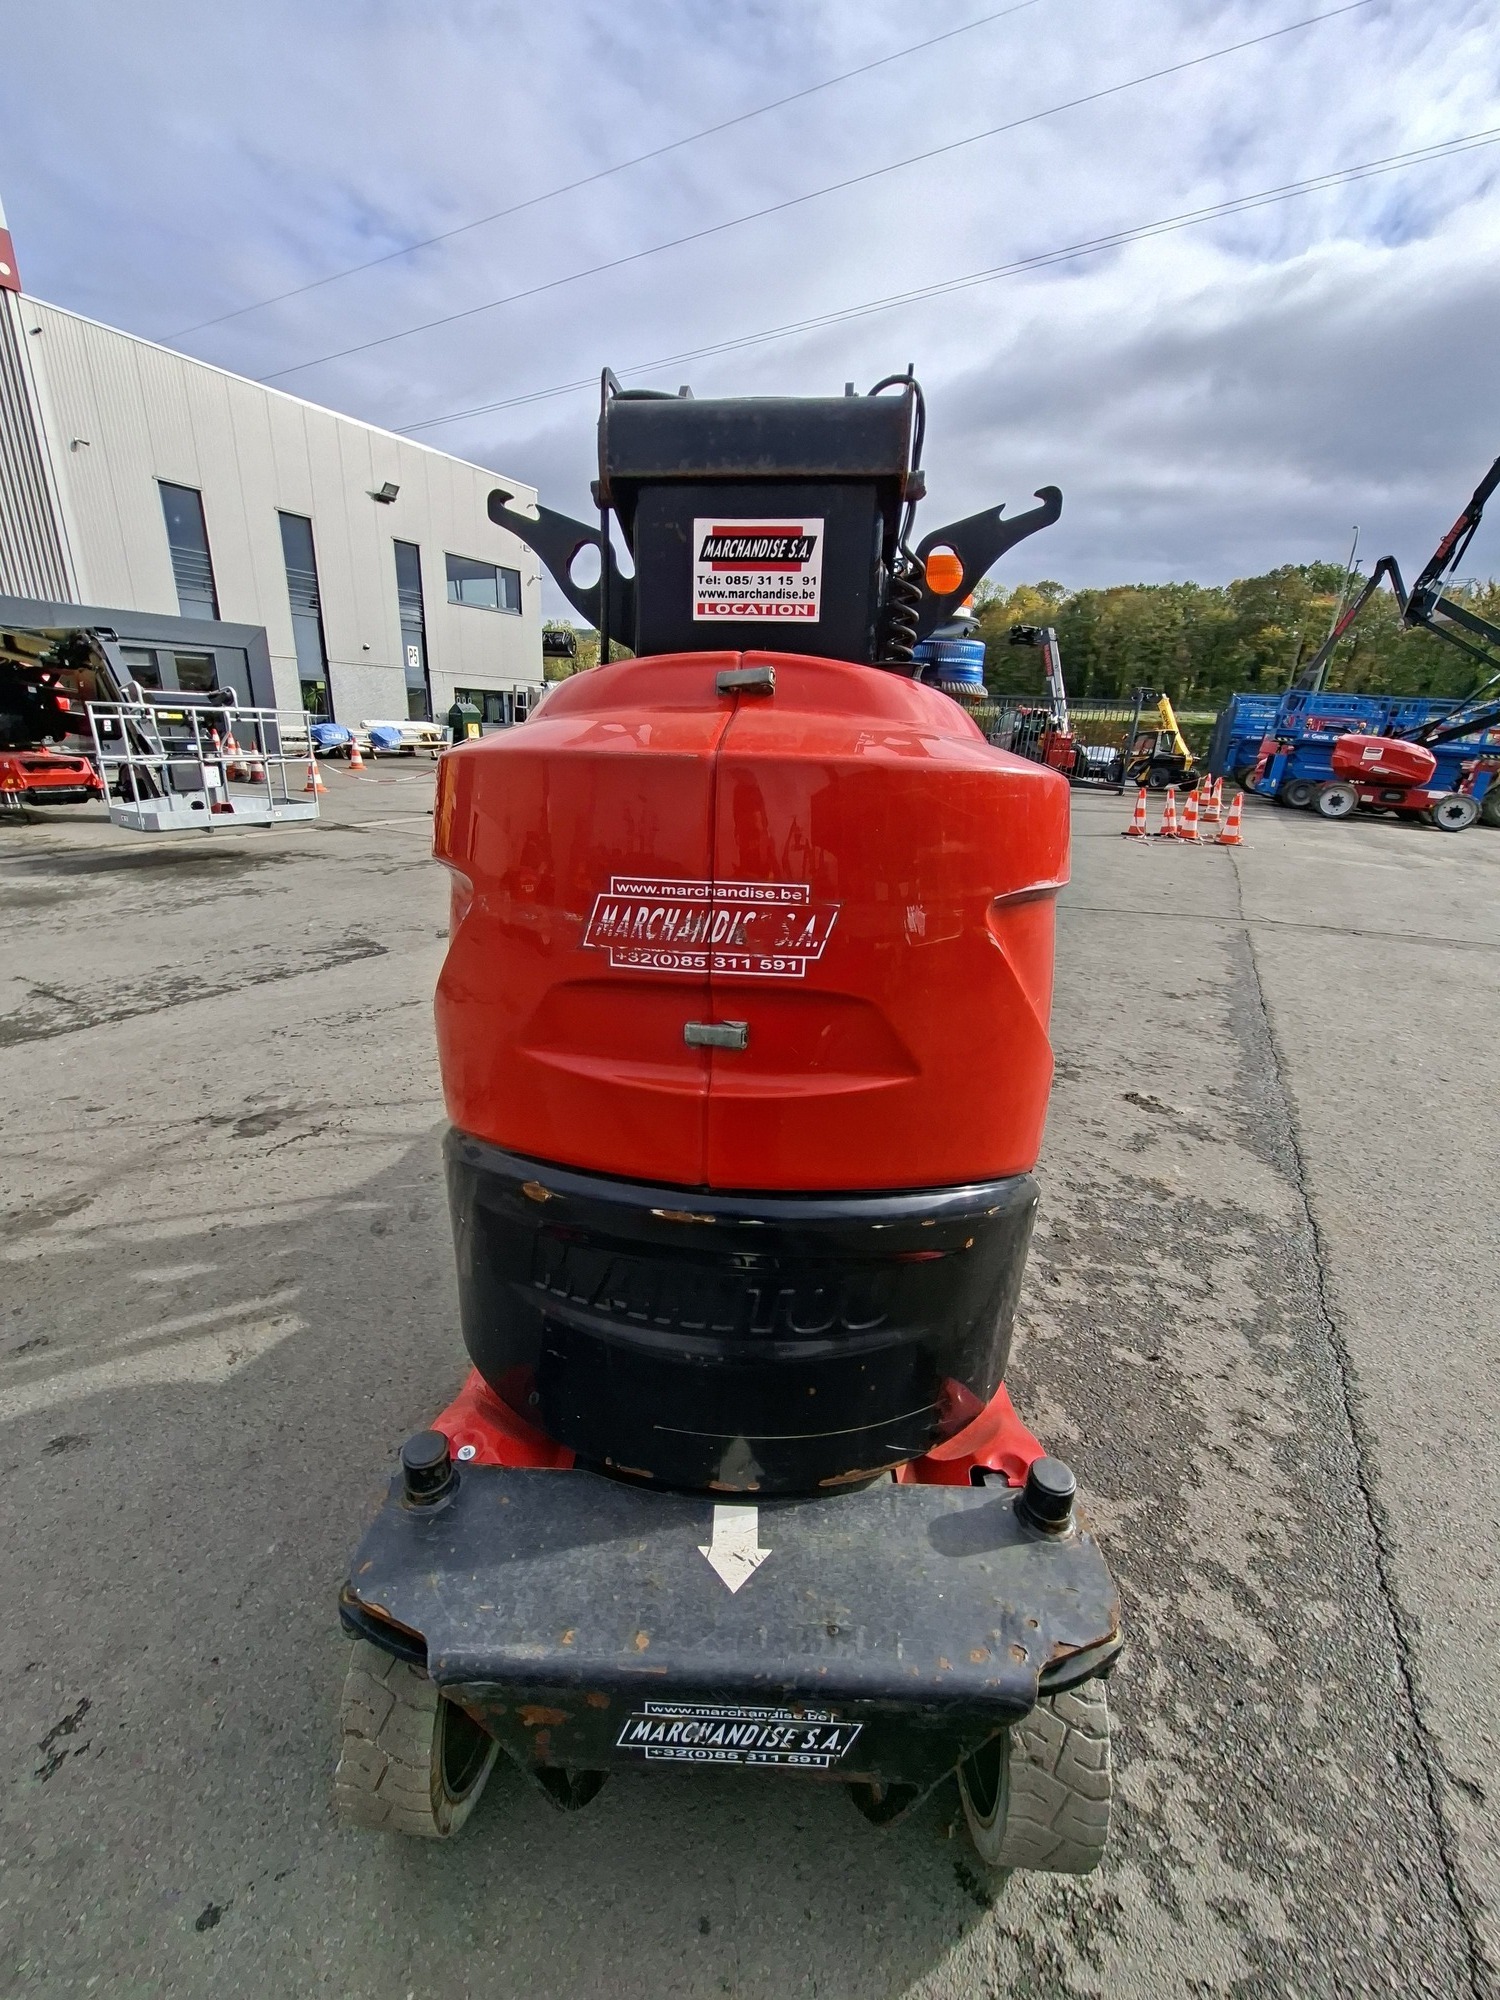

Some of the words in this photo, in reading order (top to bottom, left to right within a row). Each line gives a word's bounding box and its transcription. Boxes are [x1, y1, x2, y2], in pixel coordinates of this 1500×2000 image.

[703, 538, 788, 559] MARCHANDISE
[788, 539, 811, 559] S.A.
[697, 575, 721, 585] Tél:
[725, 575, 754, 586] 085/
[757, 576, 772, 586] 31
[777, 576, 794, 586] 15
[802, 576, 817, 586] 91
[698, 588, 816, 600] www.marchandise.be
[704, 603, 809, 616] LOCATION
[408, 647, 418, 665] P5
[616, 883, 803, 900] www.marchandise.be
[596, 904, 772, 945] MARCHANDI
[615, 952, 707, 969] +32(0)85
[713, 957, 751, 969] 311
[759, 959, 797, 972] 591
[651, 1706, 828, 1721] www.marchandise.be
[629, 1720, 799, 1750] MARCHANDISE
[801, 1726, 842, 1751] S.A.
[650, 1748, 739, 1760] +32(0)85
[747, 1752, 779, 1762] 311
[787, 1754, 822, 1764] 591
